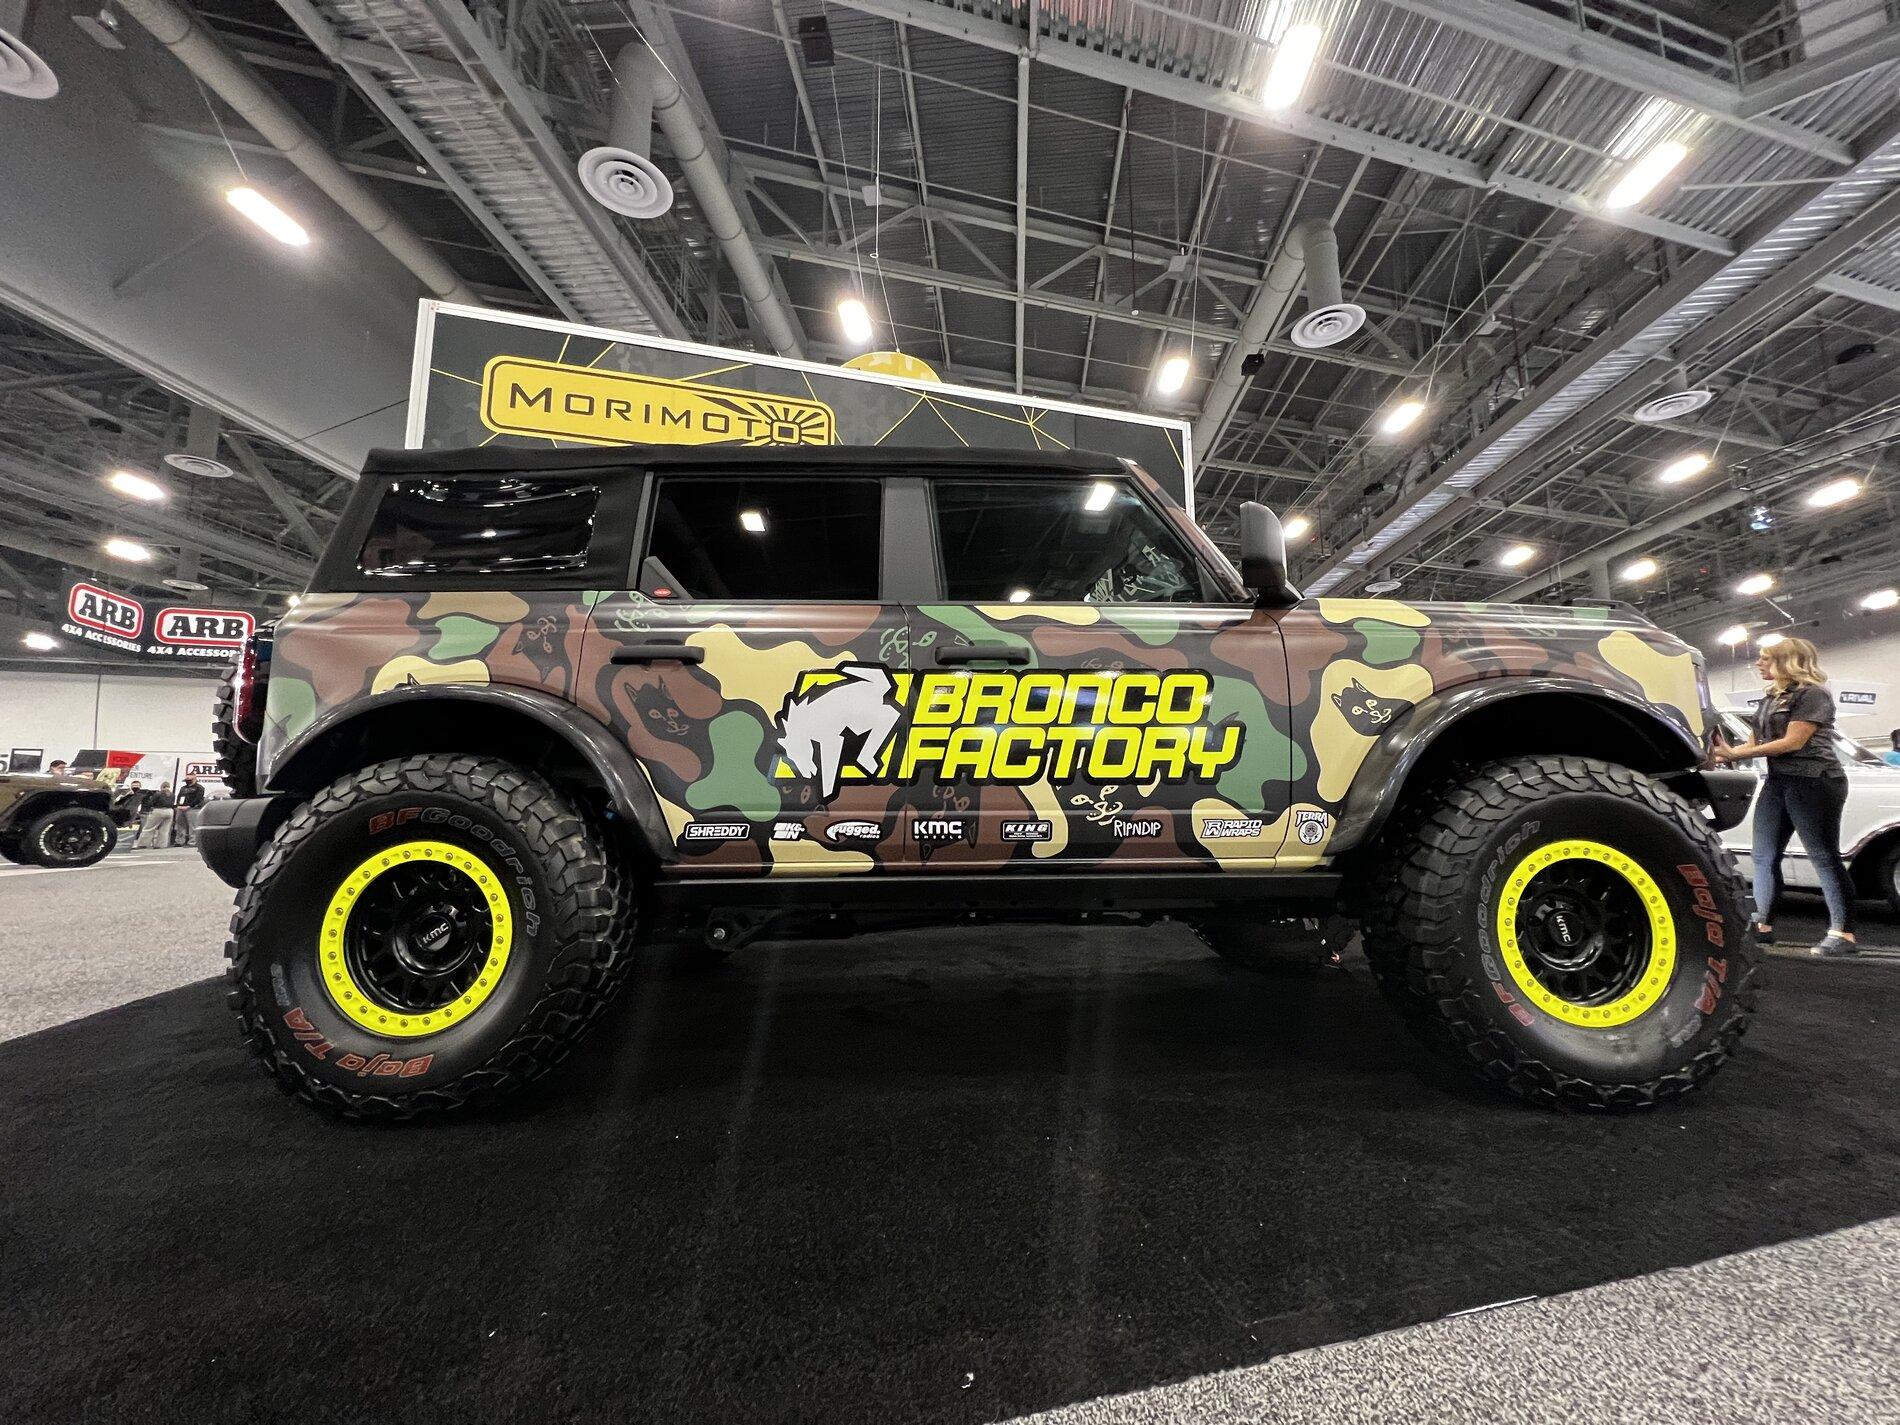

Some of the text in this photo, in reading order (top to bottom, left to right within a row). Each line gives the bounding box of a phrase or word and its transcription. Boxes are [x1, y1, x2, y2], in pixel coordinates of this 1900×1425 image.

[508, 382, 800, 444] MORIMOTO
[78, 593, 136, 630] ARB
[166, 616, 244, 639] ARB
[85, 630, 142, 653] ACCESSORIES
[177, 646, 243, 658] ACCESSOR
[911, 673, 1210, 725] BRONCO
[897, 726, 1240, 779] FACTORY
[914, 821, 962, 834] KMC
[1005, 824, 1048, 832] KING
[1114, 820, 1161, 837] RIPNDIP
[1223, 820, 1262, 829] RAPID
[1296, 811, 1328, 827] TERRA
[689, 826, 745, 837] SHREDDY
[1220, 828, 1260, 836] WRAPS
[369, 807, 540, 936] BFGoodrich
[422, 922, 449, 944] KMC
[1556, 915, 1572, 943] KMC
[336, 1054, 434, 1077] Baja
